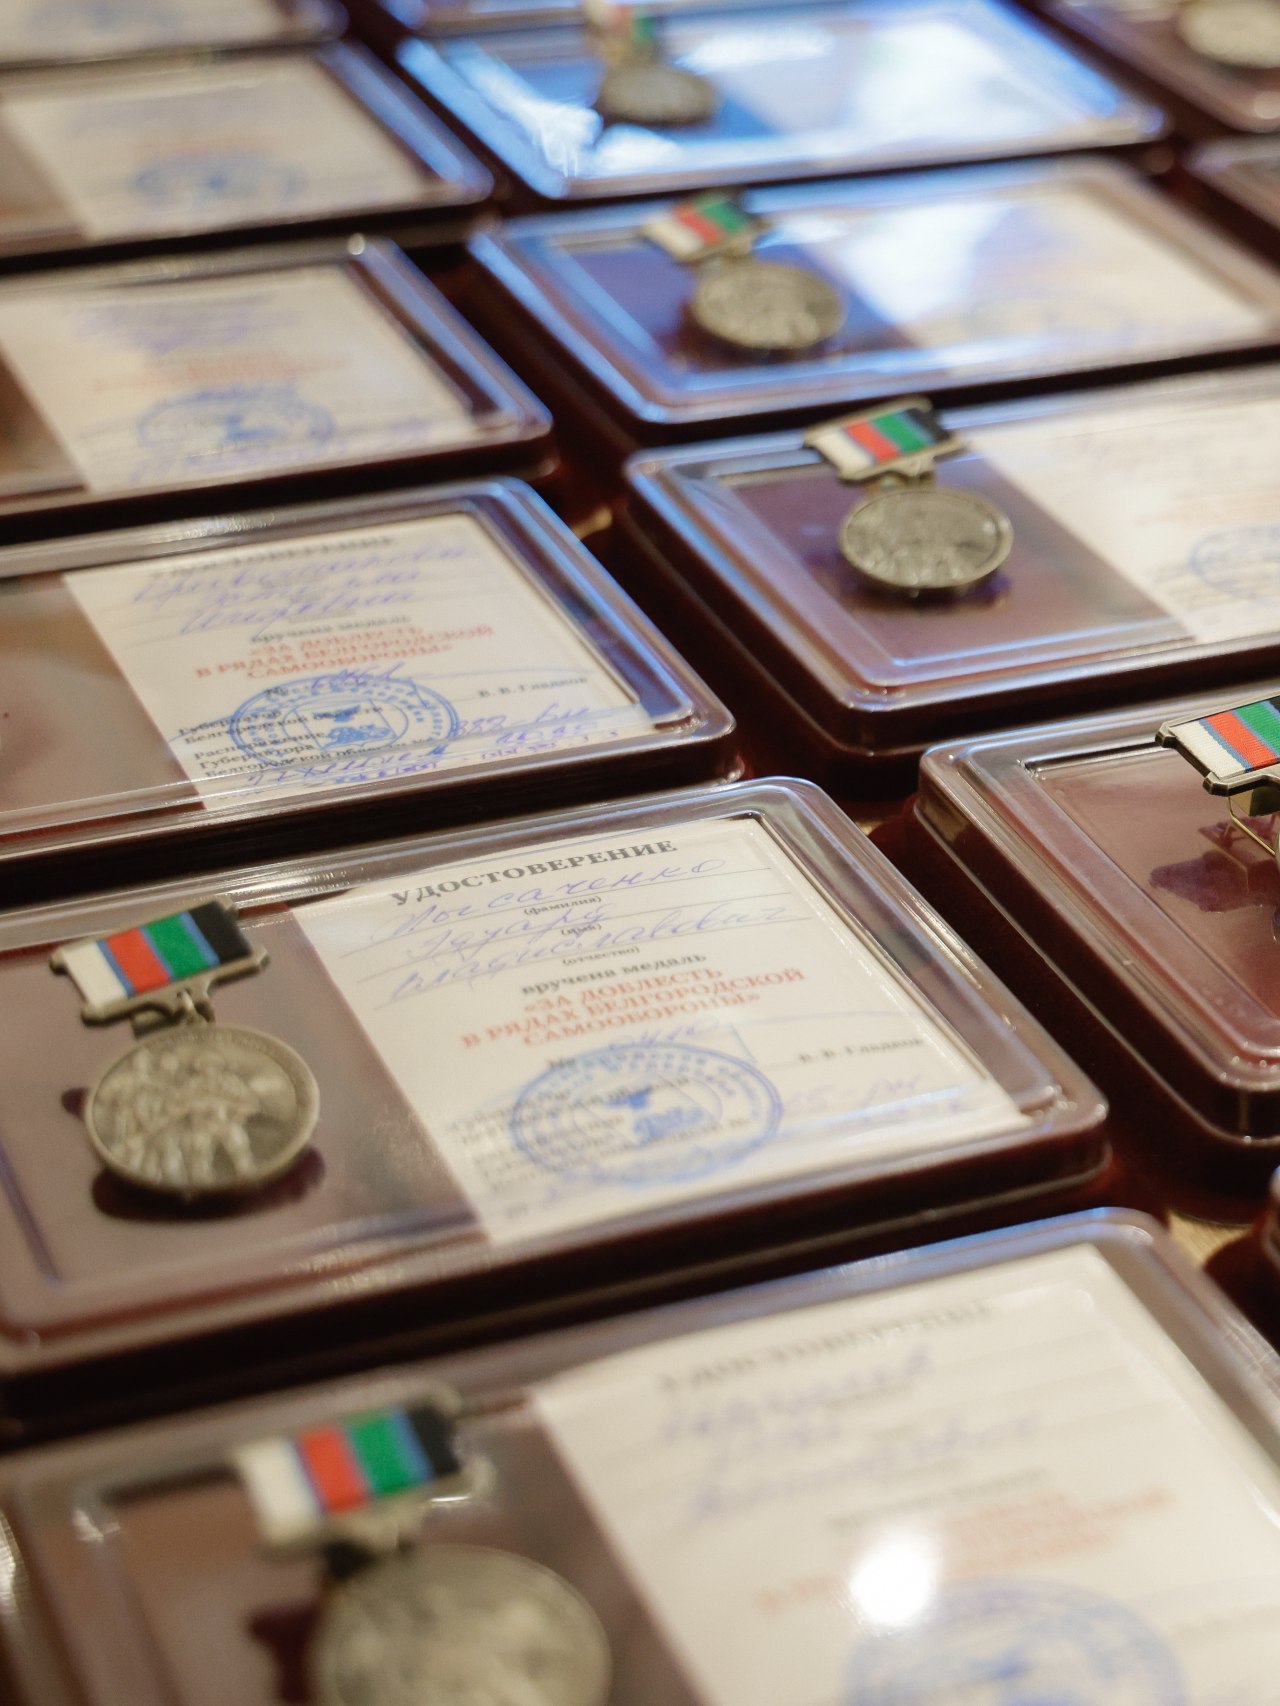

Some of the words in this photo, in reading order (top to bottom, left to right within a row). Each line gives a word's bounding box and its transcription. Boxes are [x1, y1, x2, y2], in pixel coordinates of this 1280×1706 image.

[390, 840, 678, 906] УДОСТОВЕРЕНИЕ
[523, 895, 602, 916] (фамилия)
[521, 966, 617, 997] вручена
[620, 954, 707, 979] медаль
[562, 946, 641, 966] (отчество)
[461, 1032, 483, 1049] В
[485, 1007, 581, 1042] РЯДАХ
[586, 966, 808, 1019] БЕЛГОРОДСКОЙ
[522, 994, 573, 1014] «ЗА
[579, 966, 723, 1004] ДОБЛЕСТЬ
[522, 992, 762, 1048] САМООБОРОНЫ»
